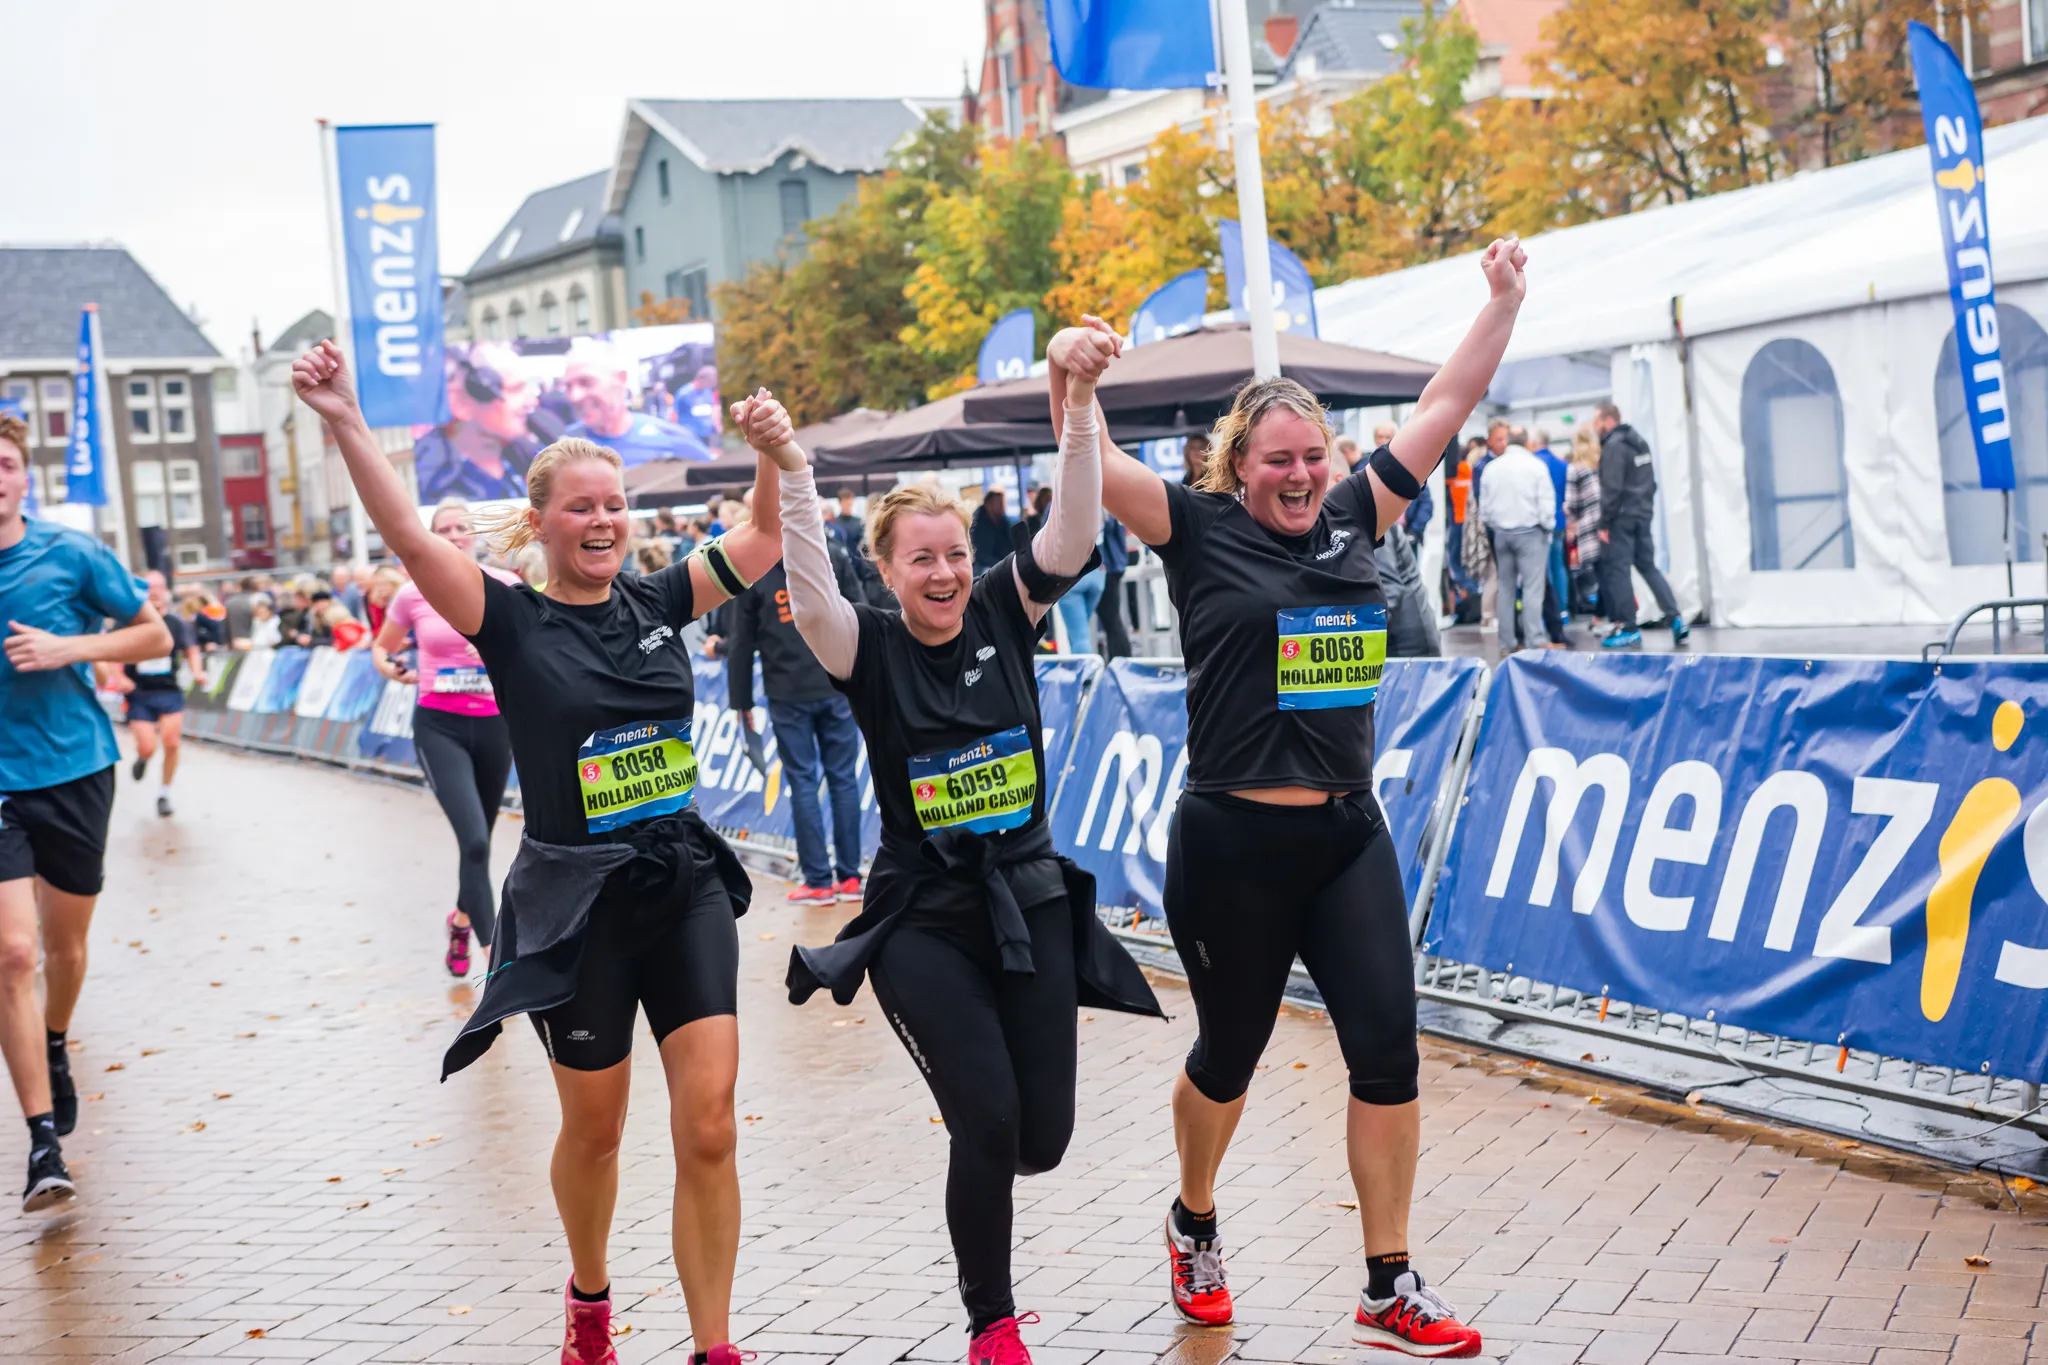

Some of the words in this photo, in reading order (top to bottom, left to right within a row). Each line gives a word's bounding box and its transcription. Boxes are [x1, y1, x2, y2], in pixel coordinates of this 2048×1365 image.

[355, 173, 425, 377] menzis
[1315, 610, 1357, 628] menzis
[1286, 645, 1294, 656] 5
[1310, 635, 1364, 663] 6068
[1280, 667, 1343, 686] HOLLAND
[1345, 664, 1383, 682] CASINO
[614, 724, 659, 745] menzis
[611, 745, 668, 781] 6058
[948, 741, 994, 769] menzis
[587, 767, 596, 780] 5
[946, 763, 1008, 800] 6059
[586, 779, 654, 811] HOLLAND
[655, 765, 698, 793] CASINO
[922, 786, 930, 799] 5
[920, 797, 986, 823] HOLLAND
[988, 783, 1035, 809] CASINO
